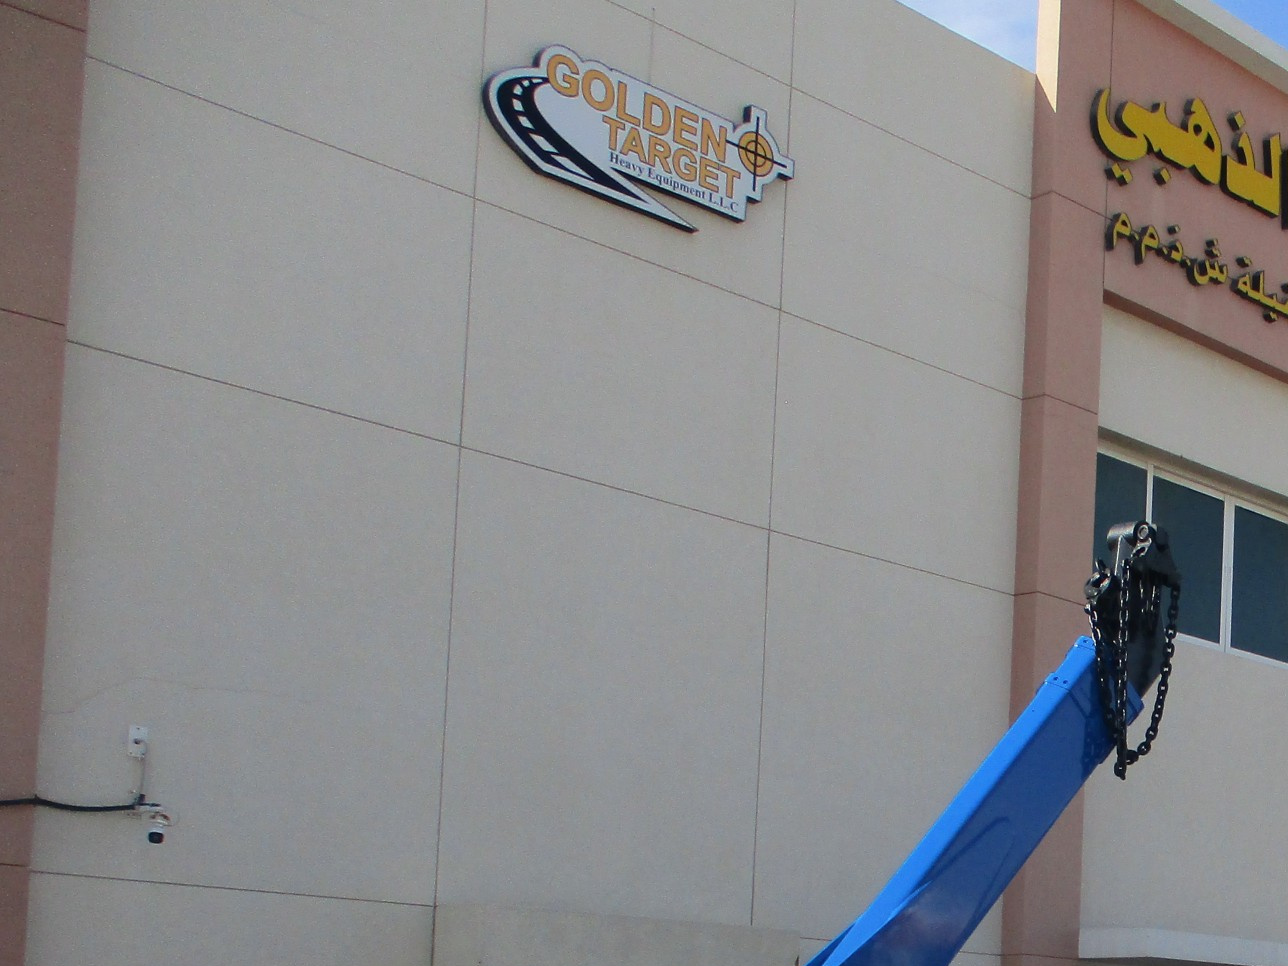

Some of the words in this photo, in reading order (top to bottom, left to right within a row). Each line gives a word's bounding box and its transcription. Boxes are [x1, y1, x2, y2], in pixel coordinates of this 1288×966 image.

[546, 53, 728, 163] GOLDEN
[602, 114, 742, 199] TARGET
[610, 152, 644, 177] Heavy
[647, 167, 706, 200] Equipment
